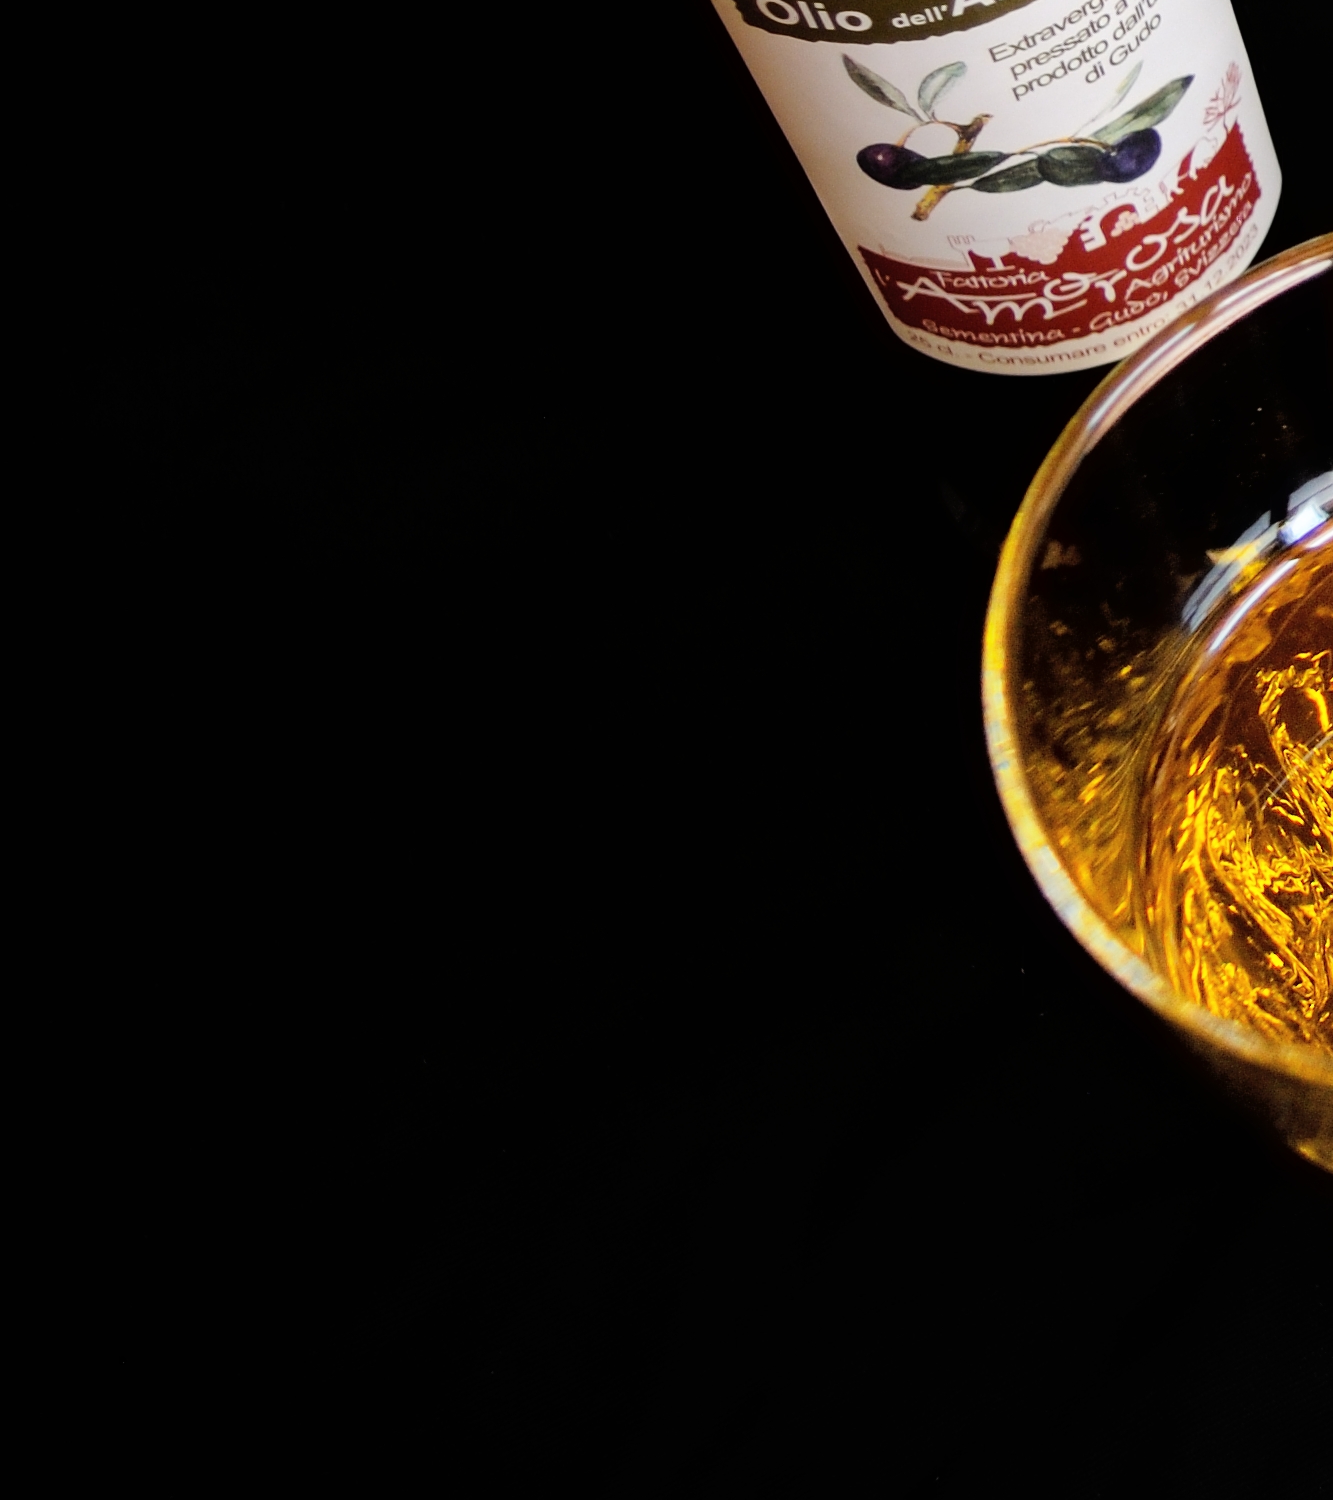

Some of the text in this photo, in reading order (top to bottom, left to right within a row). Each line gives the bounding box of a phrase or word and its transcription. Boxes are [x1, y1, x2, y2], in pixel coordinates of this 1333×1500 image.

[1010, 13, 1111, 80] pressato
[1115, 0, 1128, 16] a
[1011, 39, 1109, 101] prodotto
[1084, 13, 1162, 84] di Gudo
[1124, 172, 1252, 301] Agriturismo
[930, 268, 1050, 289] Fattoria
[922, 318, 1066, 344] Sementina
[978, 343, 1107, 365] Consumare
